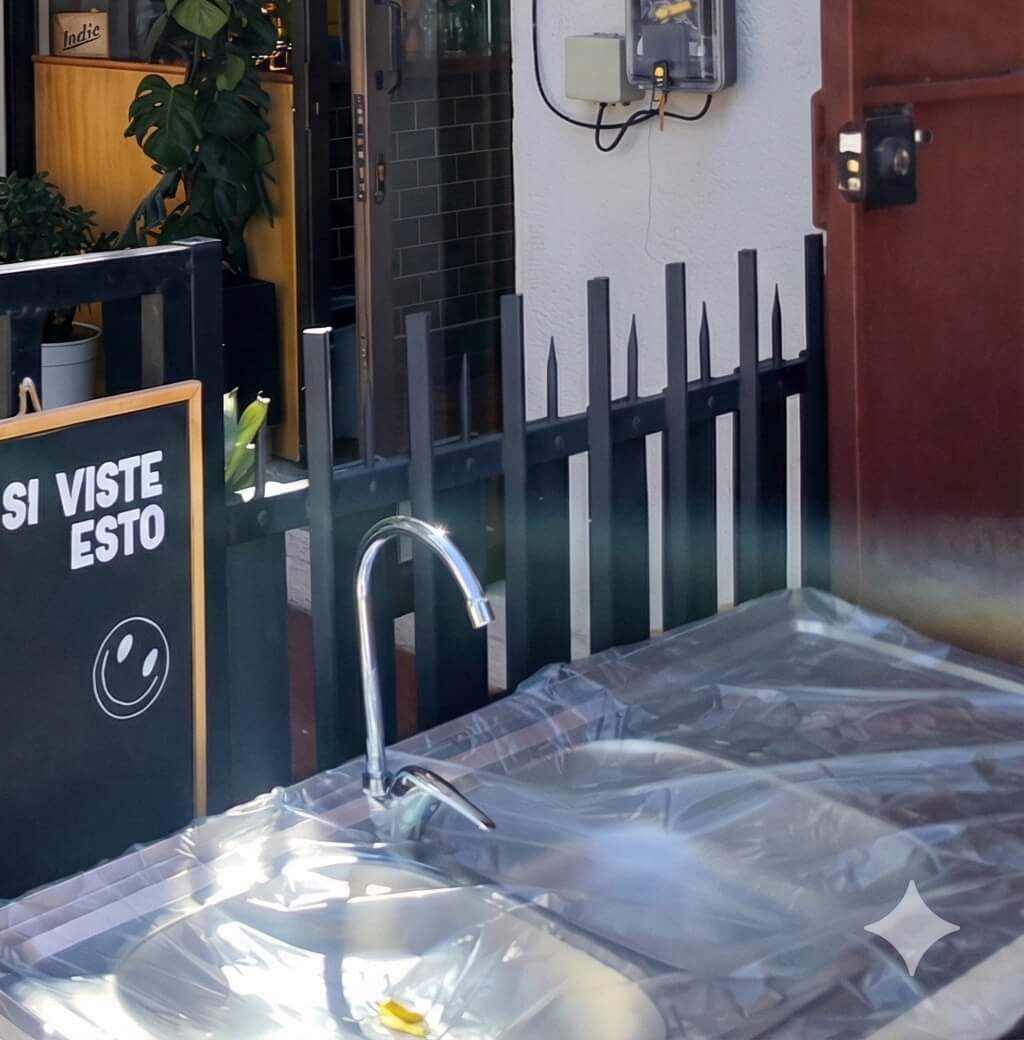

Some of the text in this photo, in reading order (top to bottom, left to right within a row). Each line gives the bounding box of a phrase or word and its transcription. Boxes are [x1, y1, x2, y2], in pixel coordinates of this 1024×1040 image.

[1, 450, 163, 530] SI VISTE
[70, 503, 166, 570] ESTO
